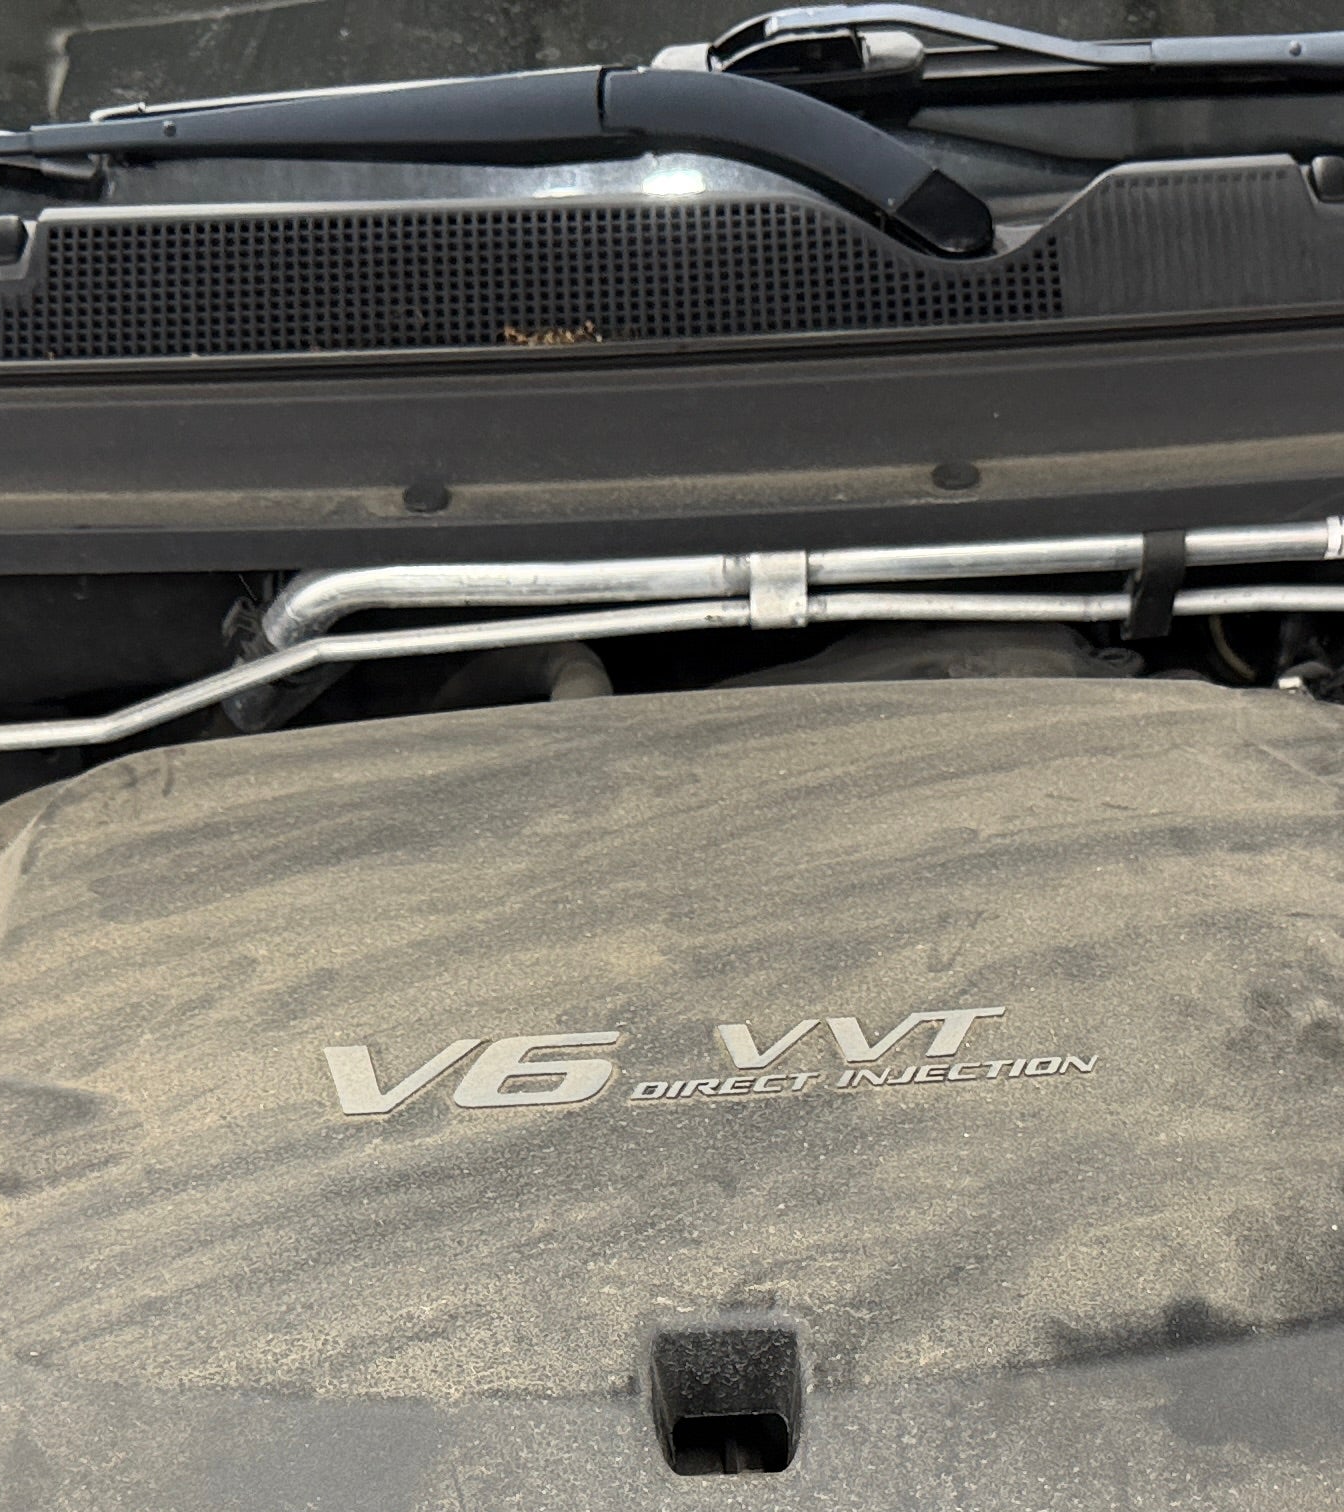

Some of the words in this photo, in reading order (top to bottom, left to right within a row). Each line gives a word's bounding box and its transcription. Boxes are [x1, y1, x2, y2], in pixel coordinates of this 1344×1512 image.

[716, 1006, 1006, 1069] VVT
[323, 1031, 622, 1115] V6
[630, 1070, 820, 1100] DIRECT
[835, 1053, 1100, 1090] INJECTION
